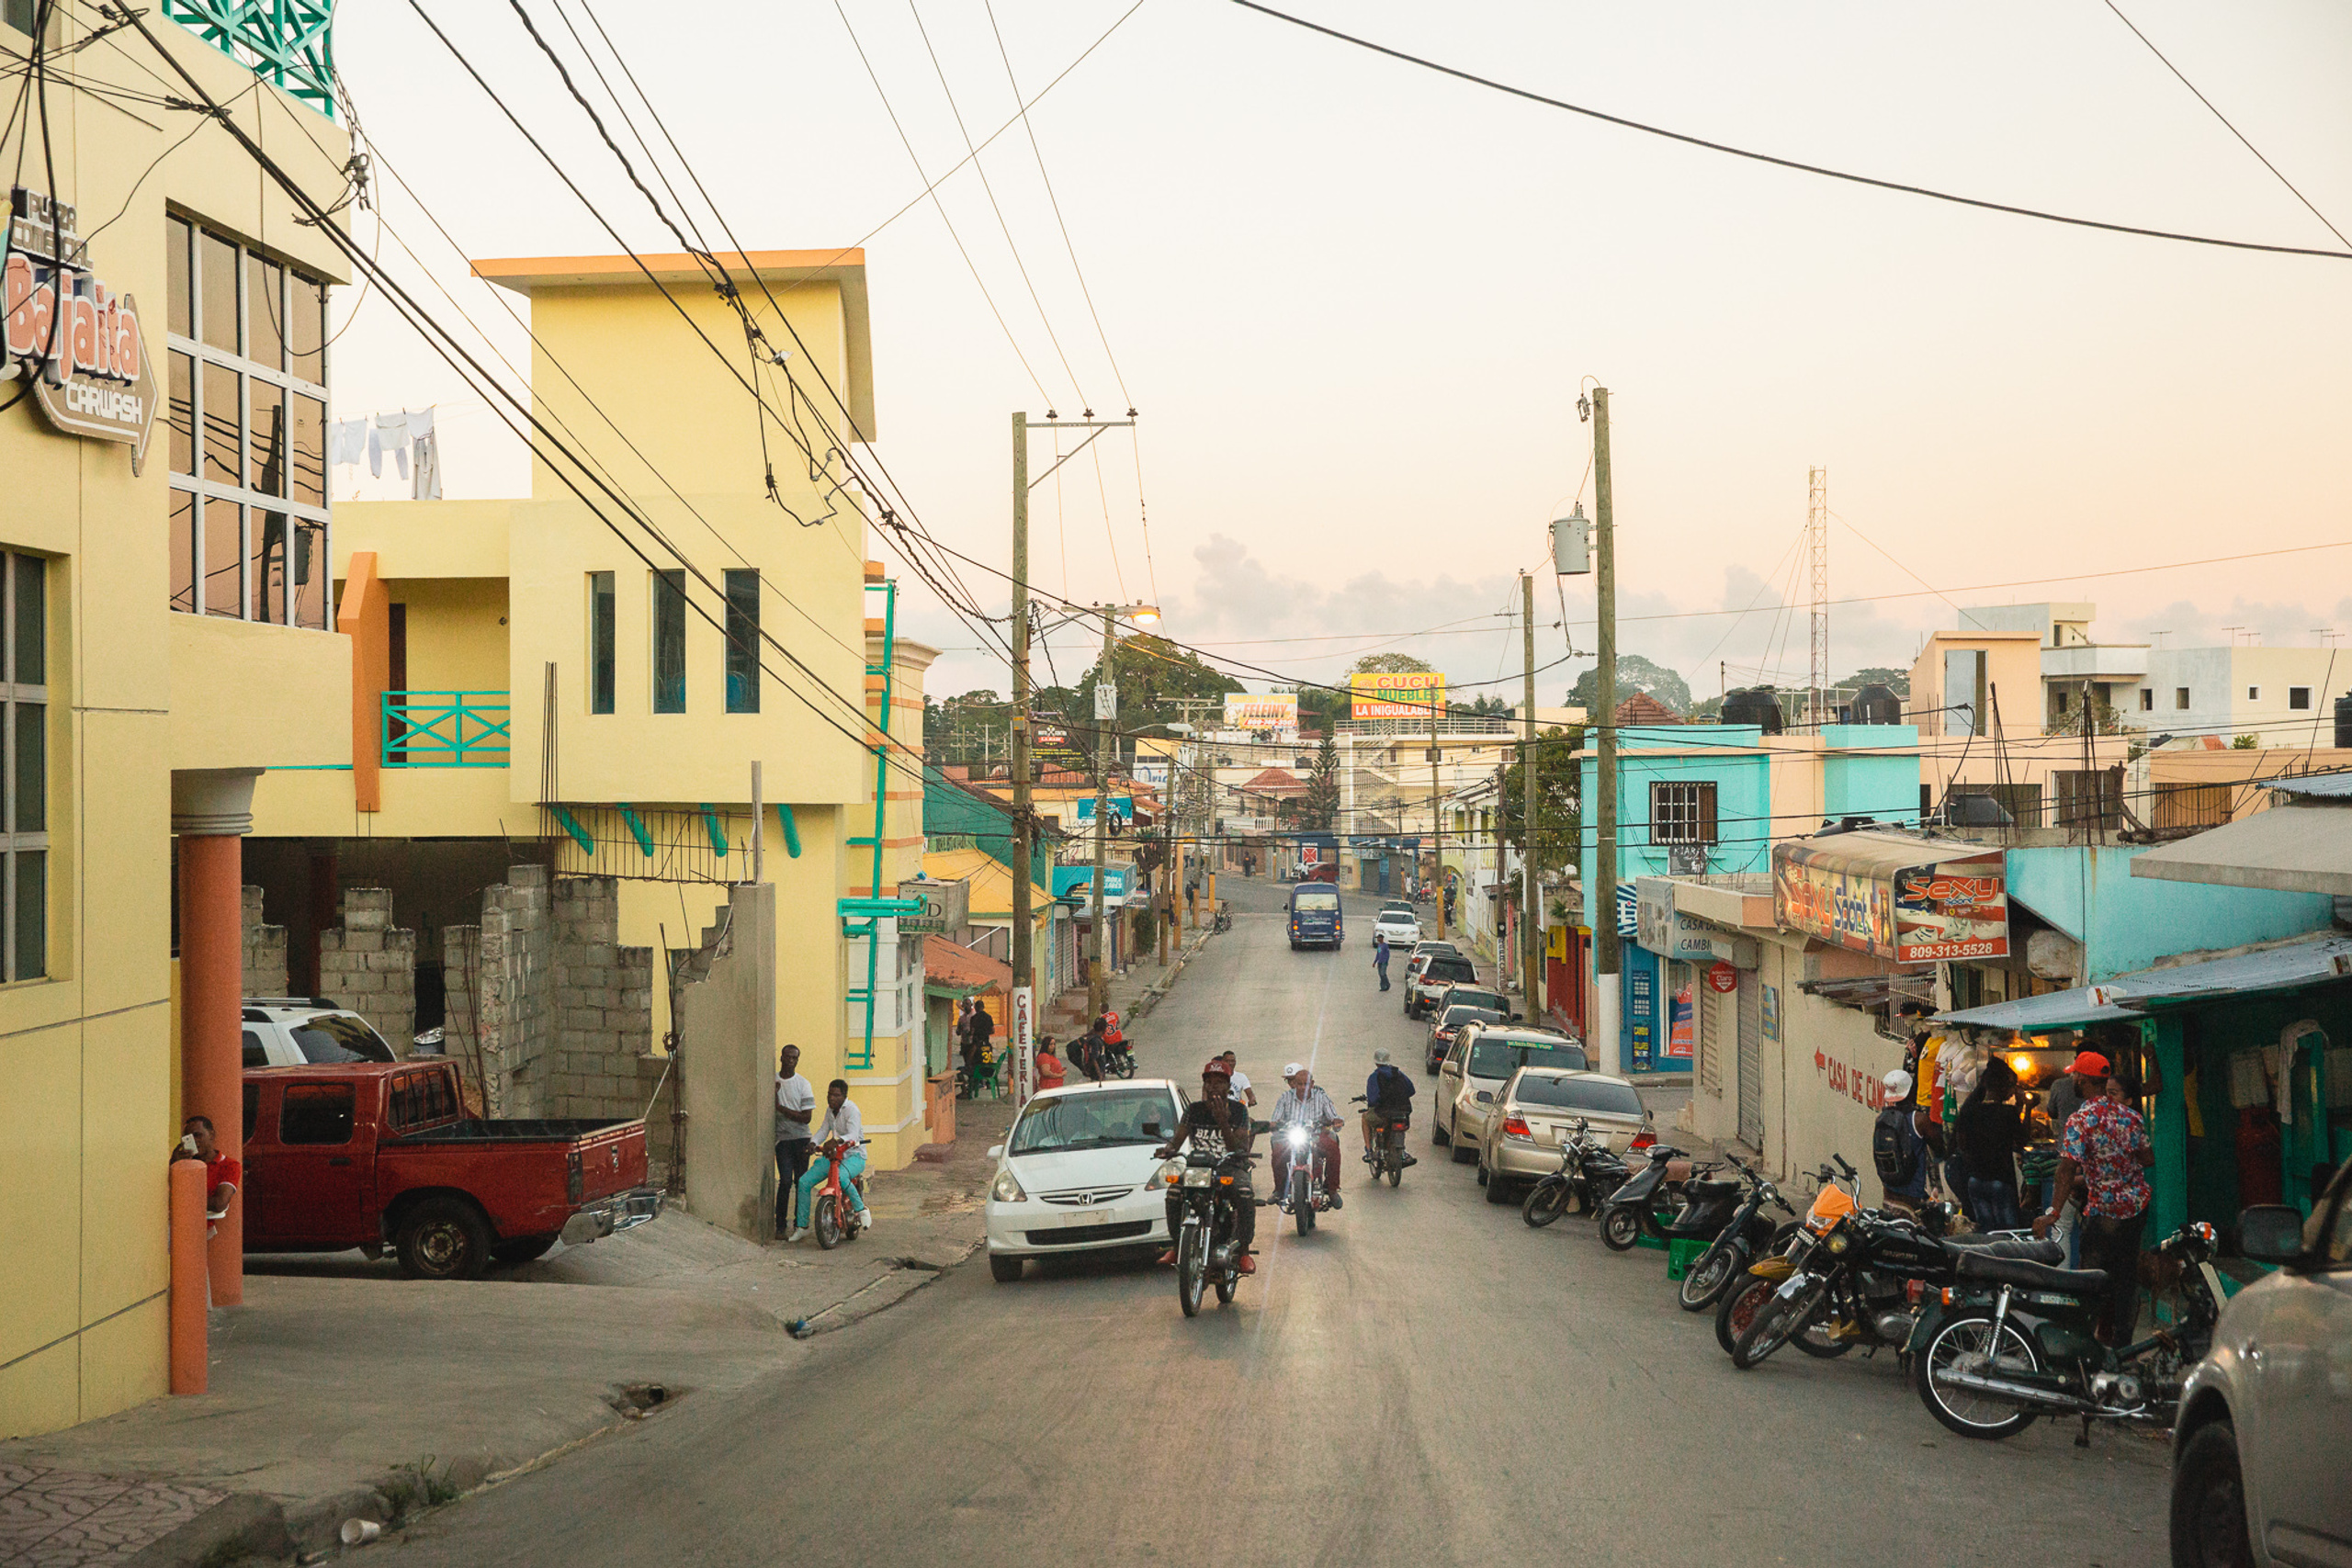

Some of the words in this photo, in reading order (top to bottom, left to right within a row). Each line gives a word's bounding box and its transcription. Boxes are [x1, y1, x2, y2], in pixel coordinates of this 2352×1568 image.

[28, 190, 77, 234] PLAZA
[11, 218, 95, 270] COMECIAL
[6, 253, 140, 384] Bajaita
[66, 382, 142, 424] CARWASH
[1376, 676, 1440, 689] CUCU
[1377, 689, 1440, 702] MUEBLES
[1356, 705, 1369, 716] LA
[1371, 705, 1439, 716] INIGUALABL
[1905, 876, 1999, 902] Sexy
[1785, 879, 1833, 939] Sexy
[1945, 897, 1973, 906] Sport
[1680, 919, 1704, 931] CASA
[1680, 939, 1713, 951] CAMBI
[1909, 942, 1994, 958] 809-313-5528
[1017, 994, 1028, 1108] CAFETERIA
[1828, 1056, 1848, 1096] CASA
[1851, 1068, 1863, 1104] DE
[1866, 1076, 1885, 1112] CAM
[2041, 1294, 2080, 1306] HONDA
